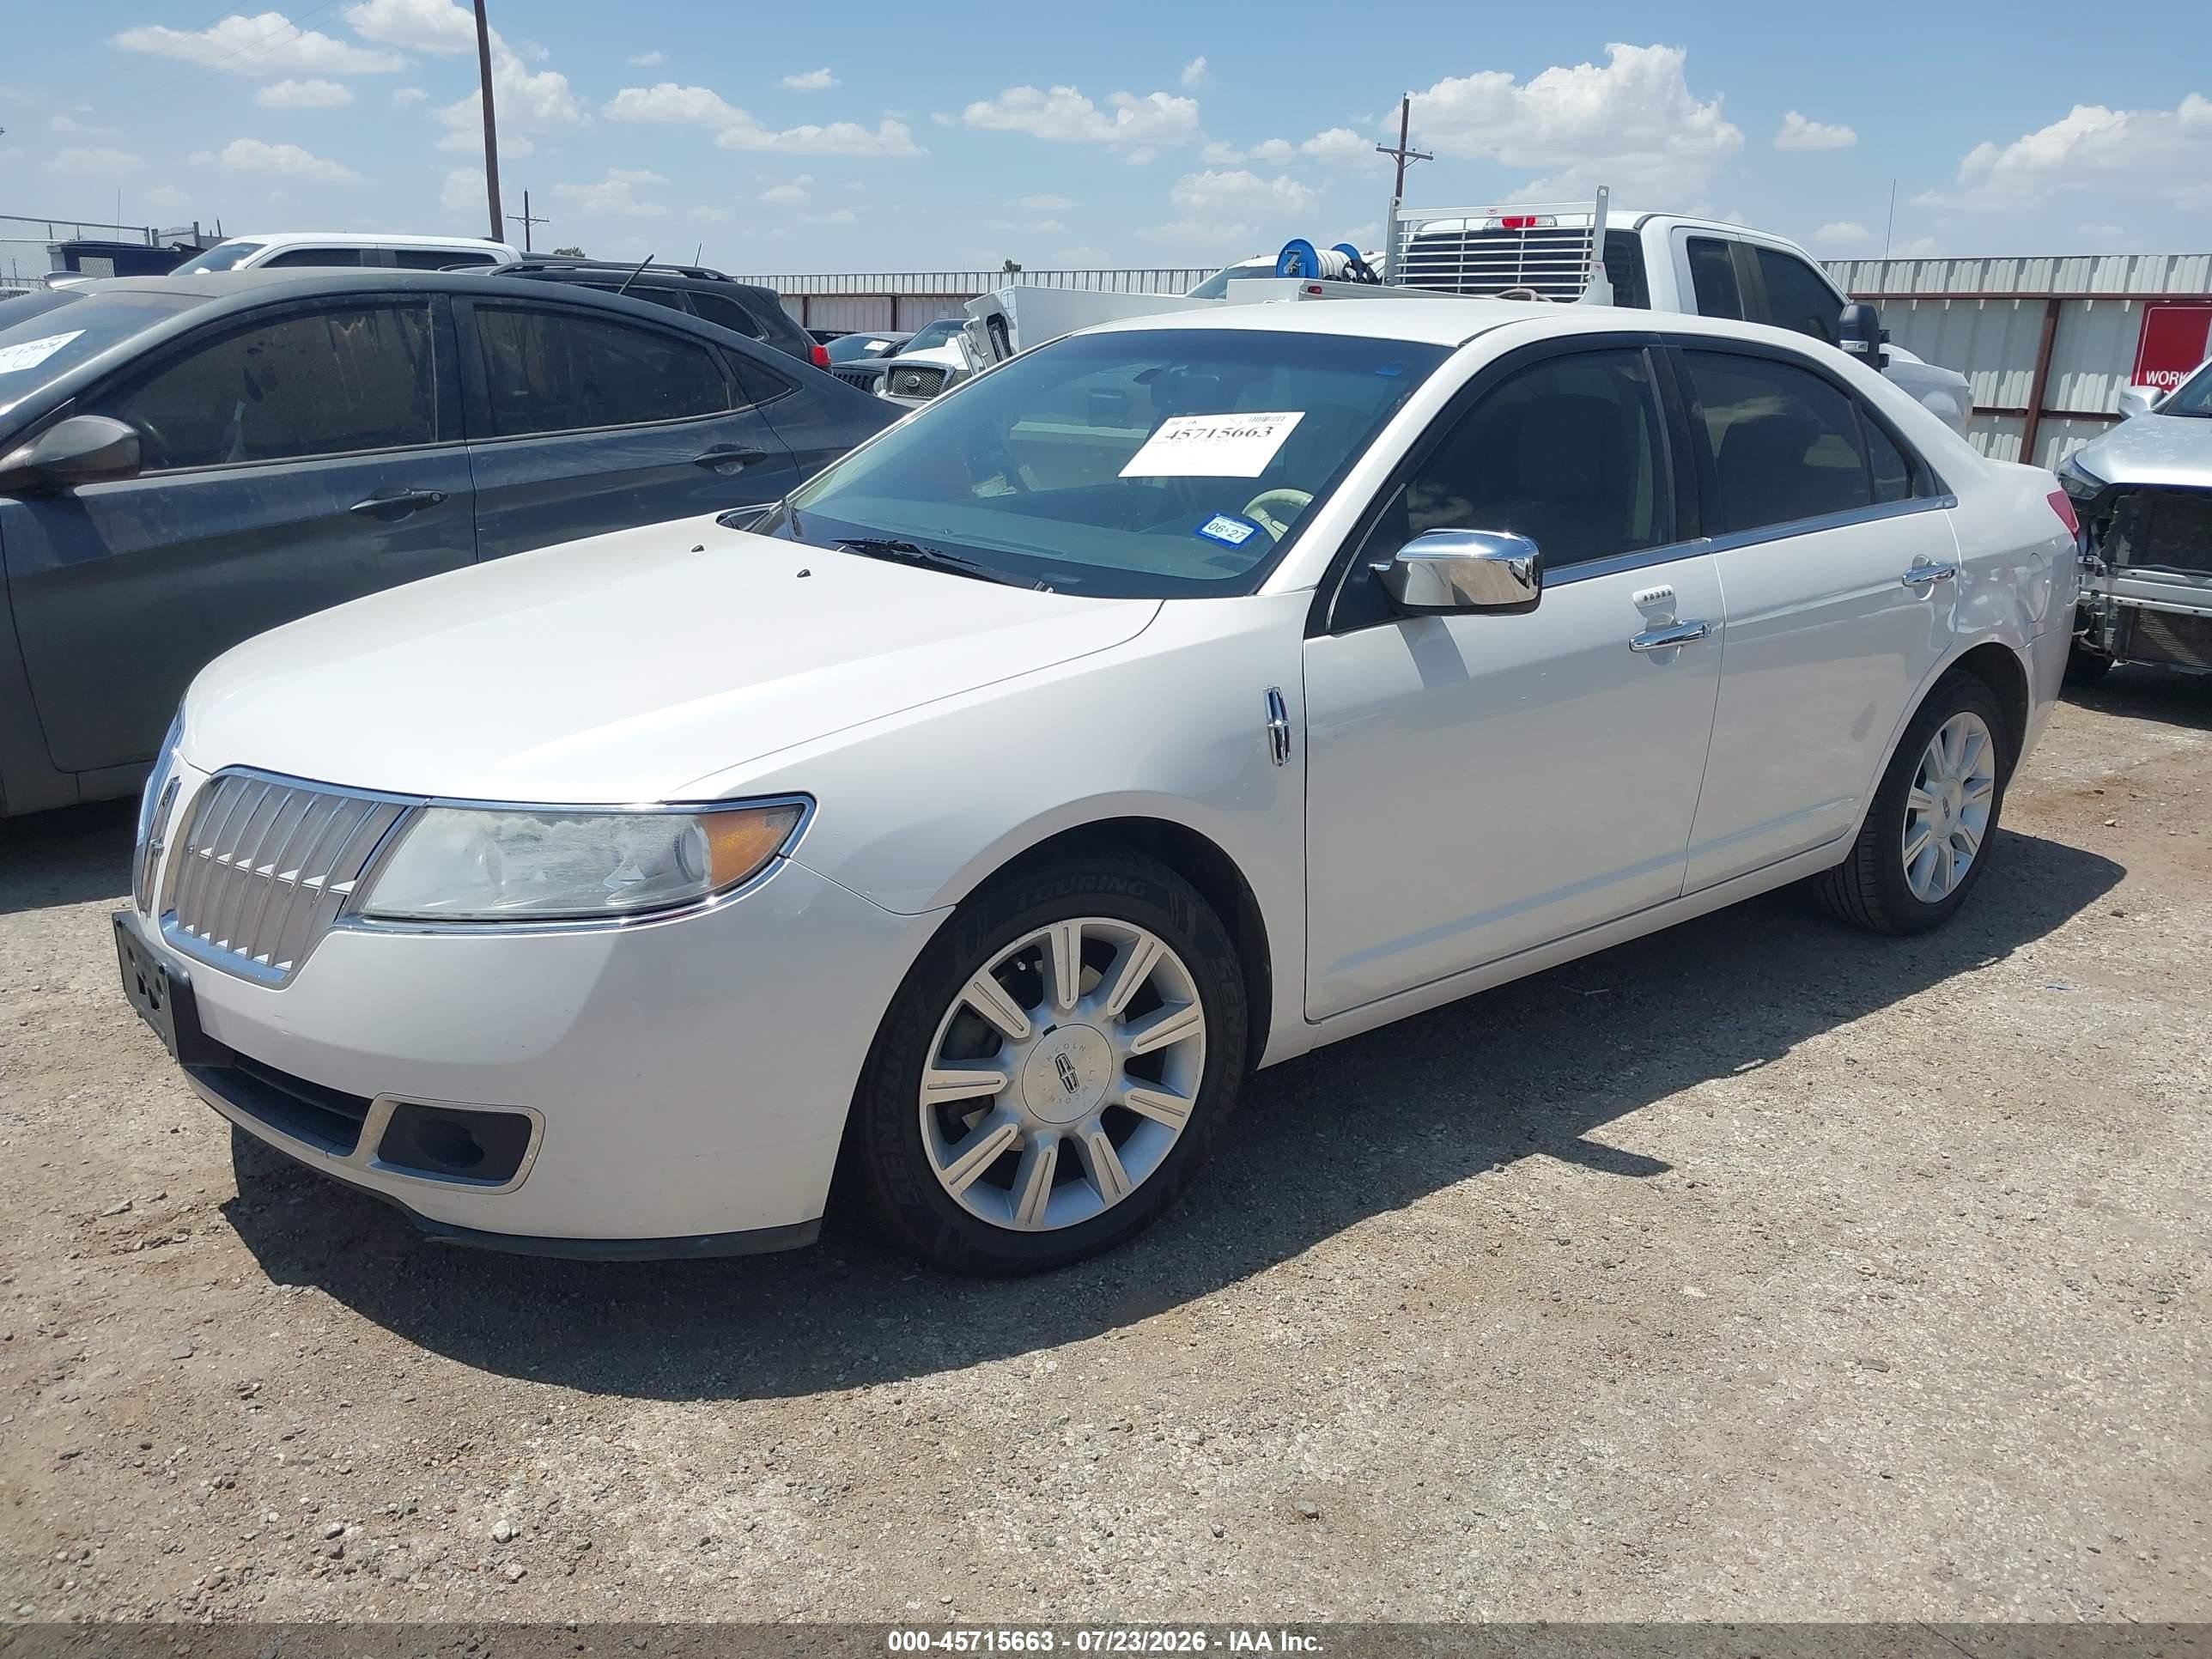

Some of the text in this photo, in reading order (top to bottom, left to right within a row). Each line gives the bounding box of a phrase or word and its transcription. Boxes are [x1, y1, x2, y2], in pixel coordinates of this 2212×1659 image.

[1164, 426, 1274, 441] 45715663
[1015, 875, 1149, 910] TOURING
[1039, 1043, 1086, 1078] LINCOLN
[1049, 1070, 1096, 1104] LINCOLN
